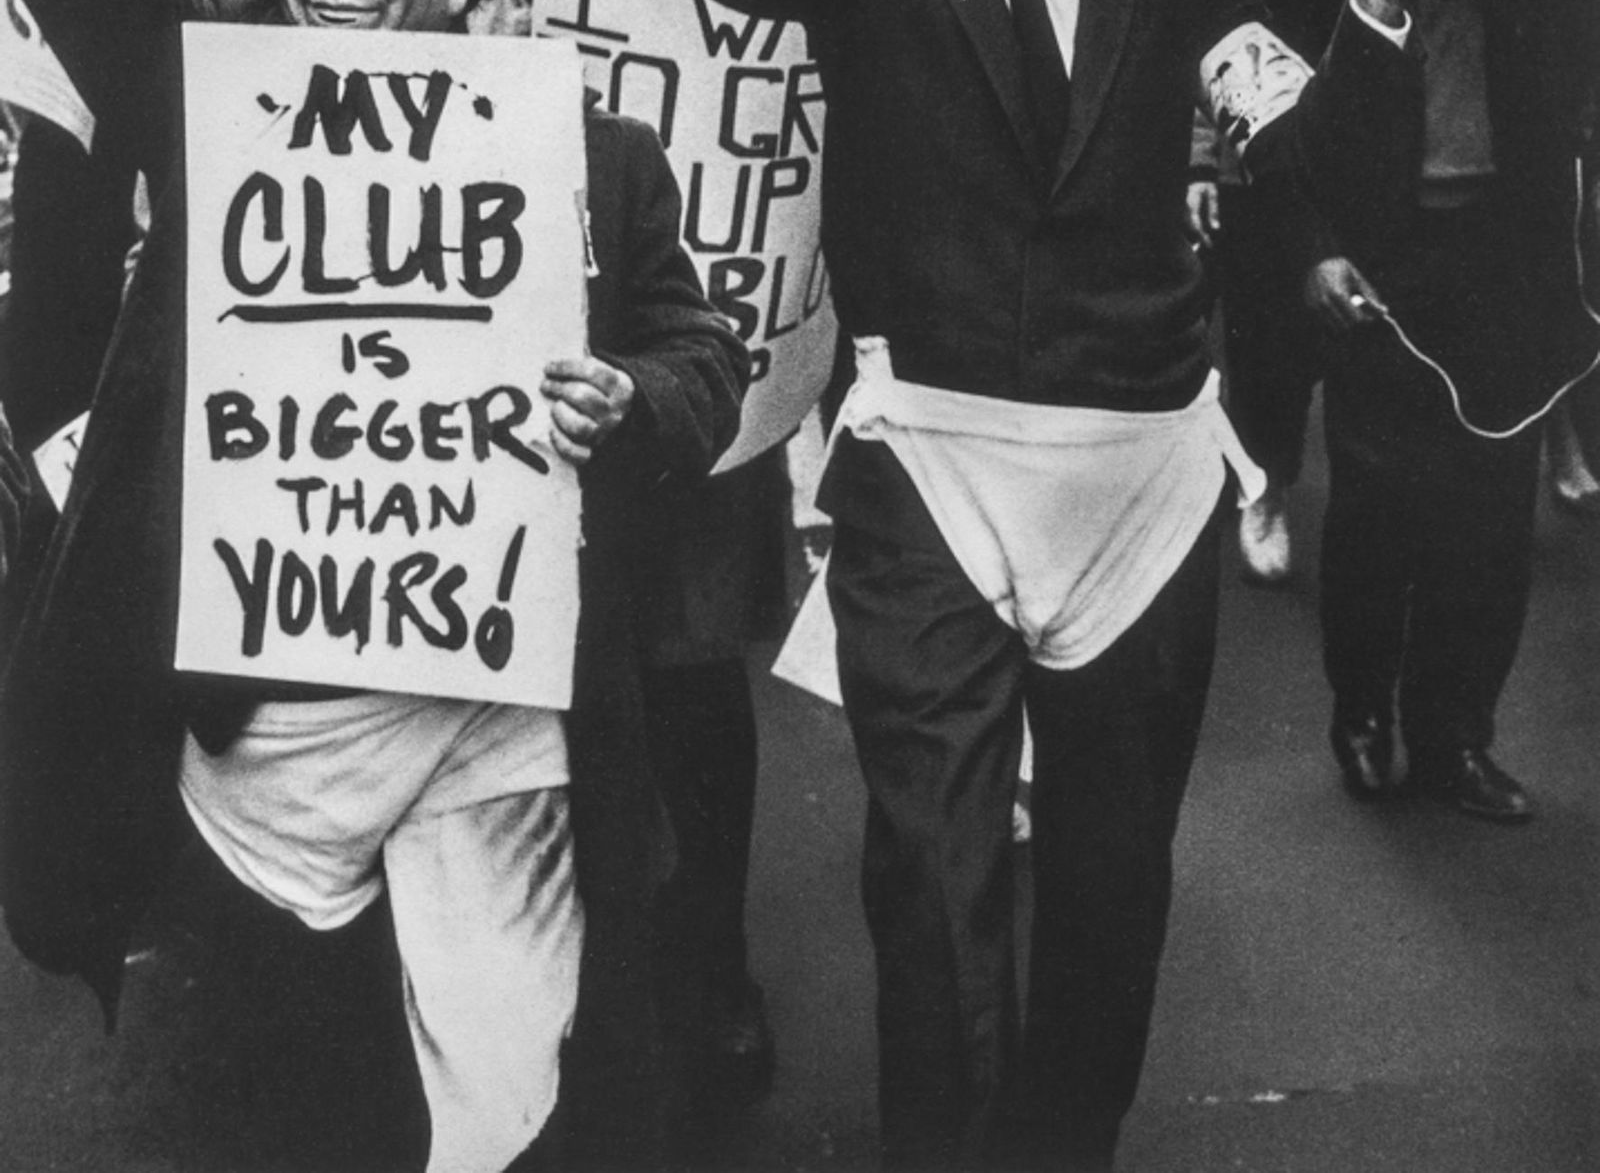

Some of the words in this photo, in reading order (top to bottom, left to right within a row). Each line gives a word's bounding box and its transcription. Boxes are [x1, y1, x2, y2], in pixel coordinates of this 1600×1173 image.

[286, 63, 453, 162] MY
[222, 170, 526, 299] CLUB
[682, 156, 812, 254] UP
[342, 330, 410, 379] IS
[204, 385, 550, 475] BIGGER
[276, 477, 476, 537] THAN
[213, 525, 527, 672] YOURS!
